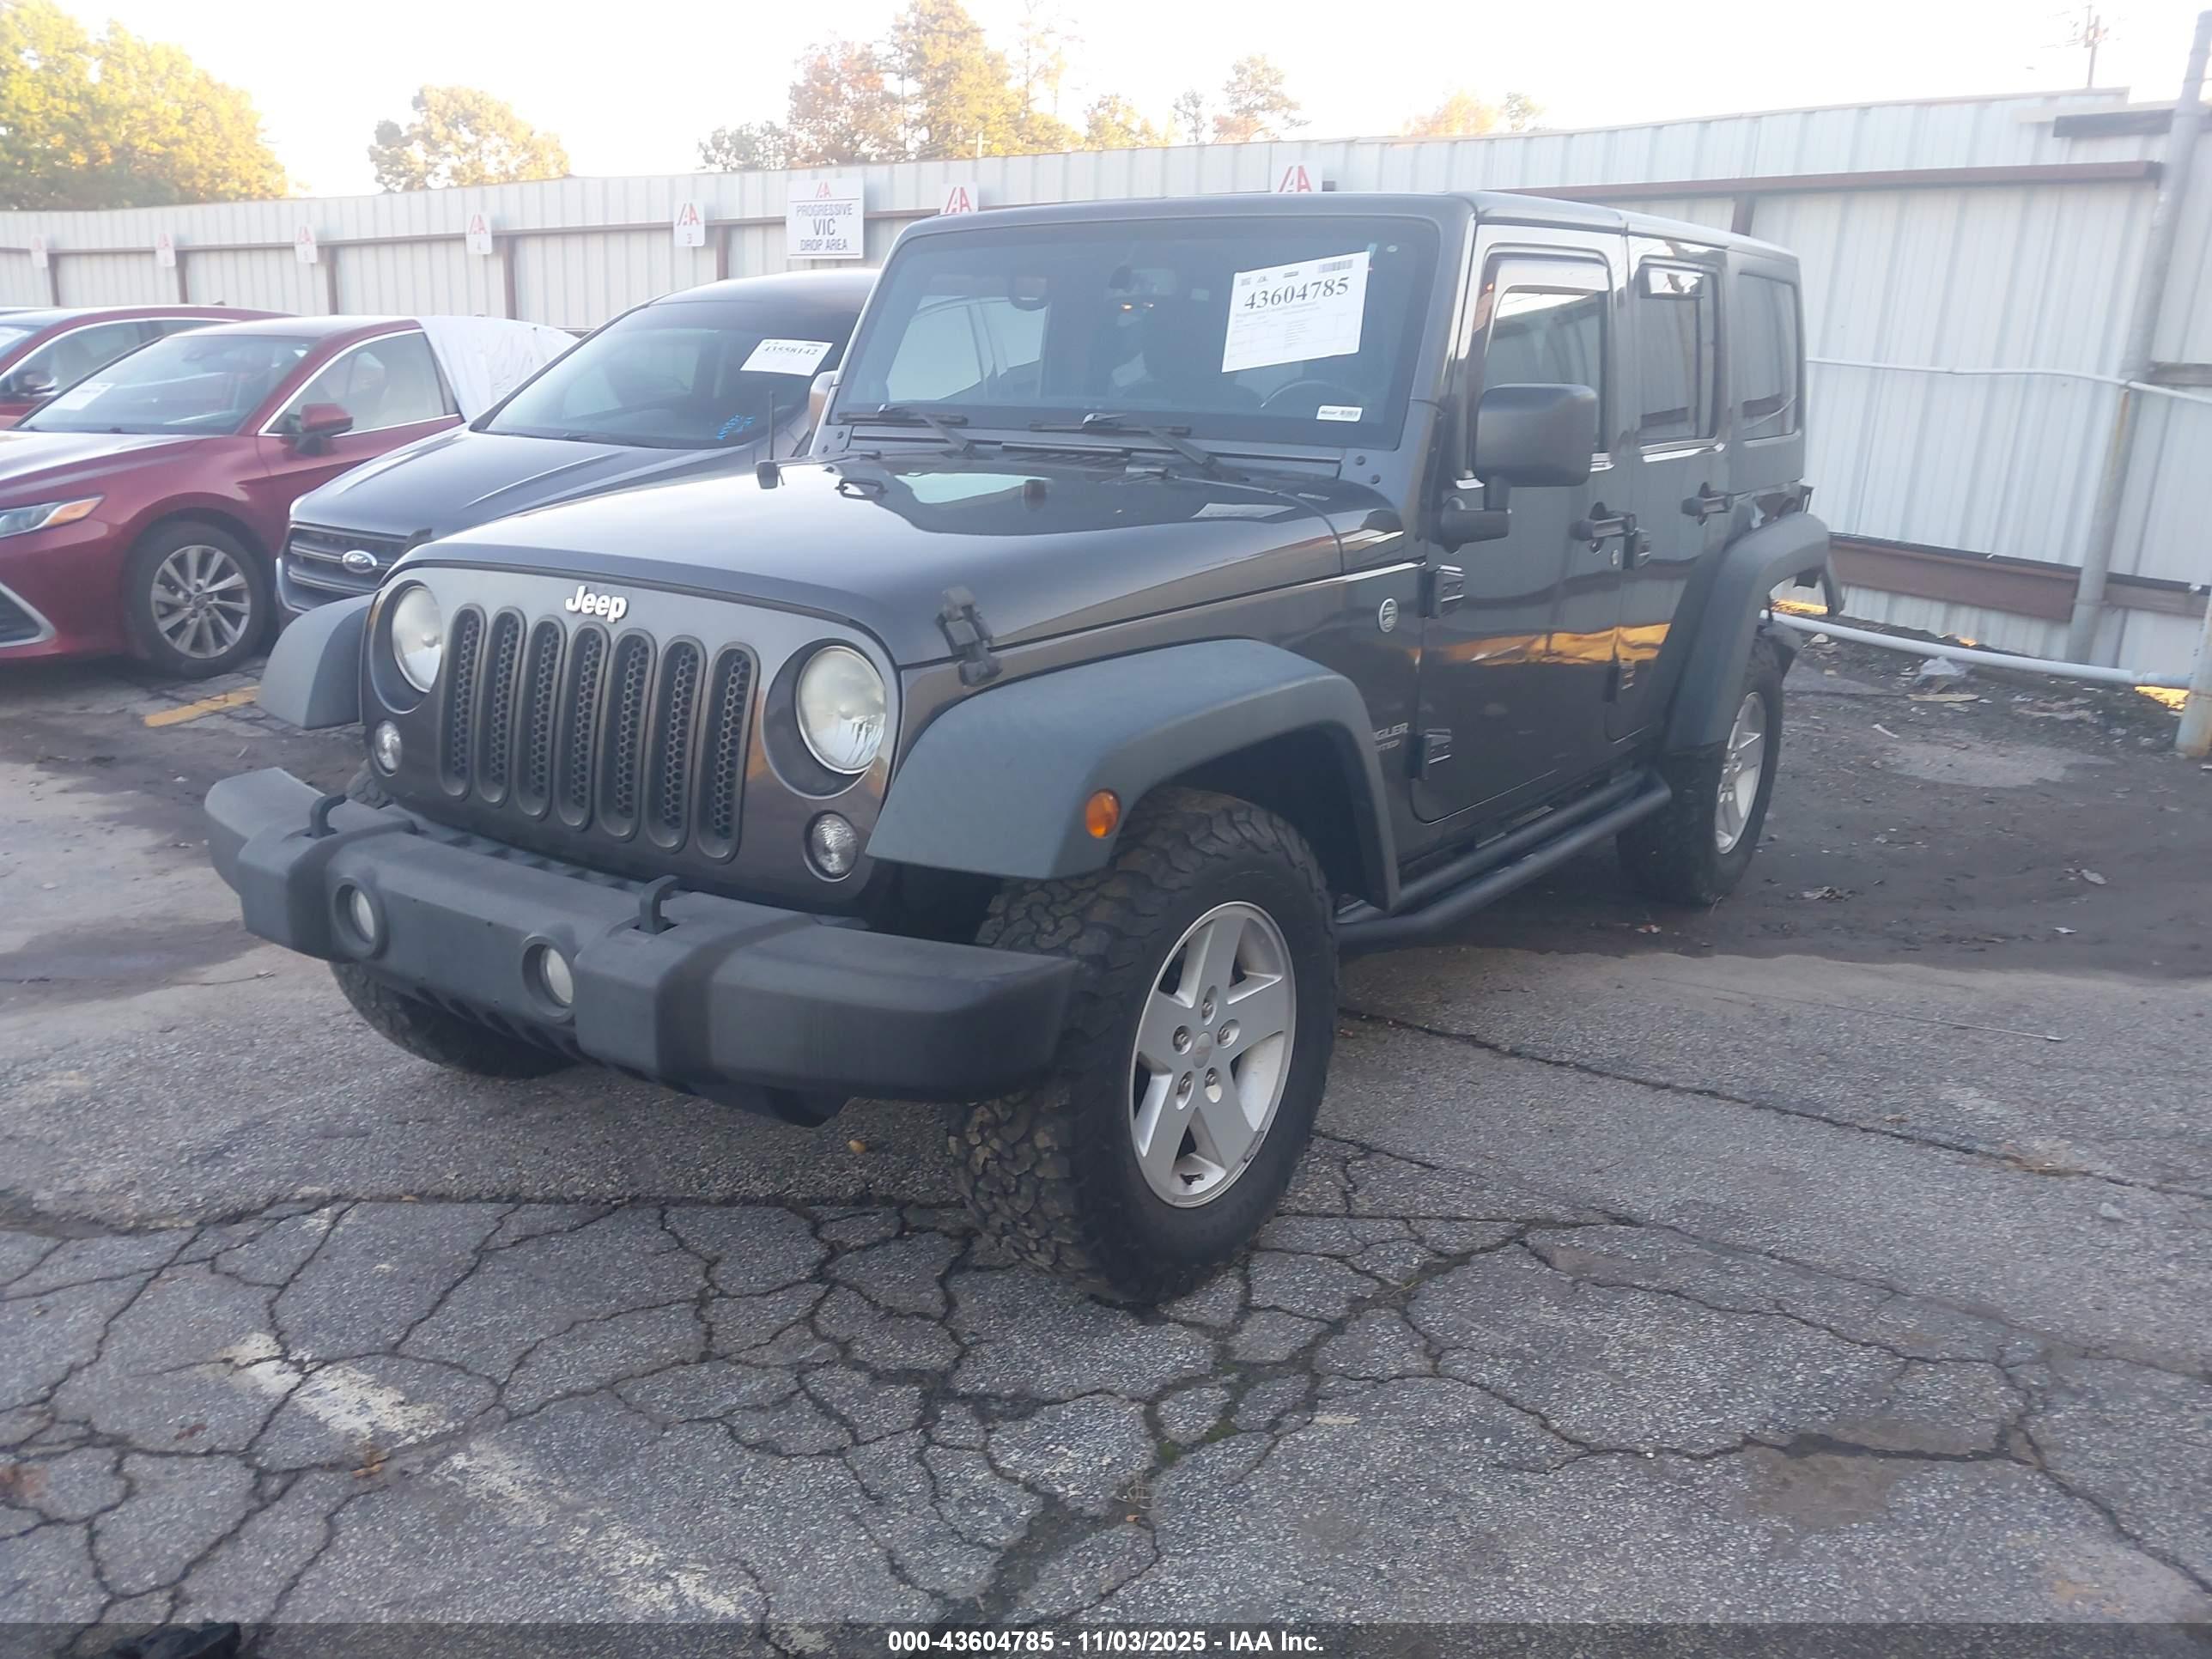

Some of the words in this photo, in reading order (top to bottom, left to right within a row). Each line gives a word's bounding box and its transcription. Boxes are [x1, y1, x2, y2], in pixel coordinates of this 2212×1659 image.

[796, 204, 853, 217] PROGRESSIVE
[813, 218, 836, 236] VIC
[800, 239, 823, 252] DROP
[825, 238, 848, 251] AREA
[1244, 276, 1350, 310] 43604785
[565, 585, 629, 623] Jeep
